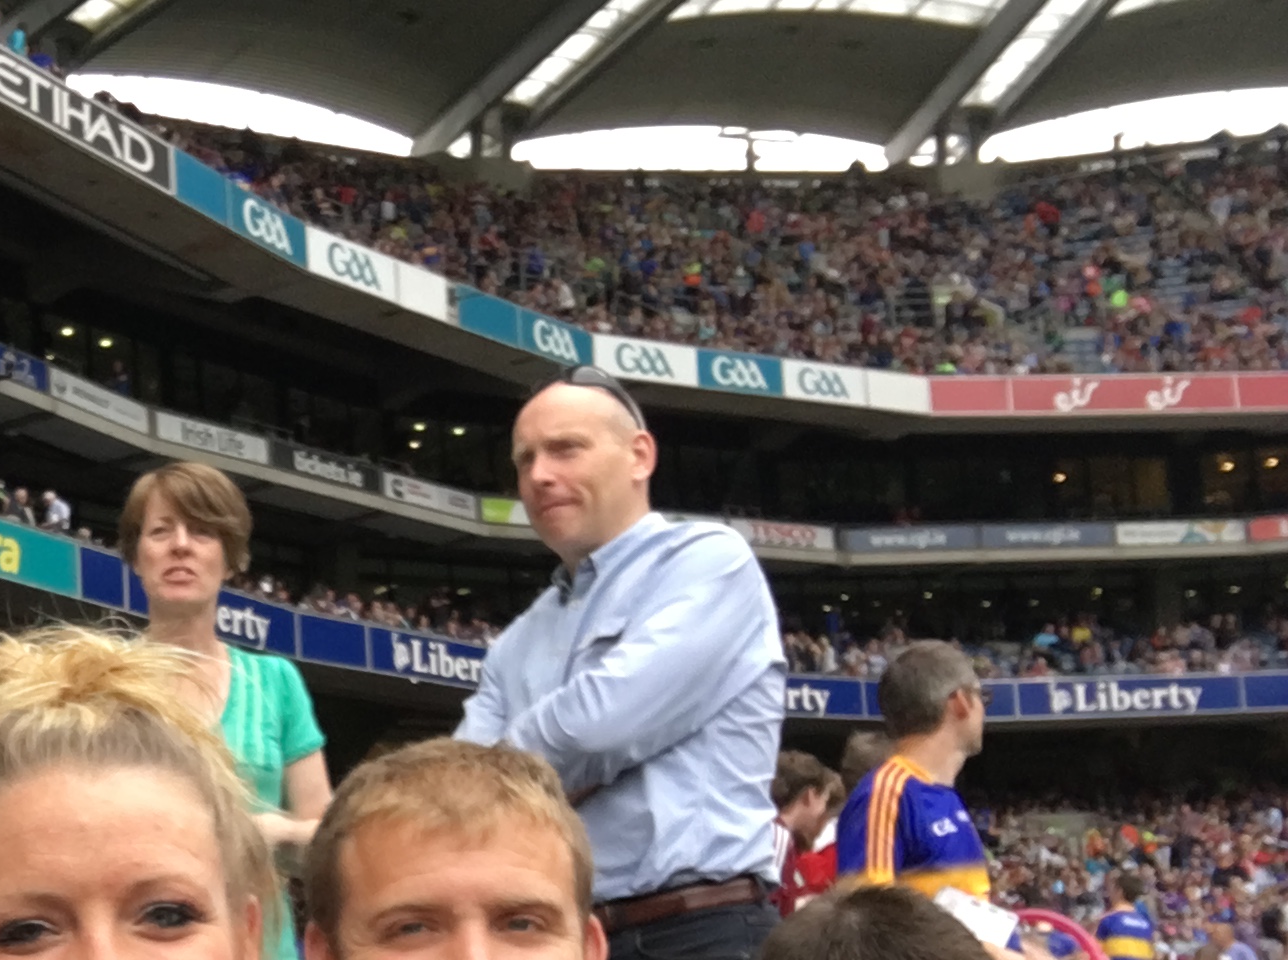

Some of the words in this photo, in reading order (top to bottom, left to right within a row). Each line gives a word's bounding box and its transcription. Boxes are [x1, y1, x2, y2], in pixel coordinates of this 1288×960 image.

[216, 604, 270, 649] erty
[411, 638, 482, 682] Liber
[1073, 681, 1203, 713] Liberty
